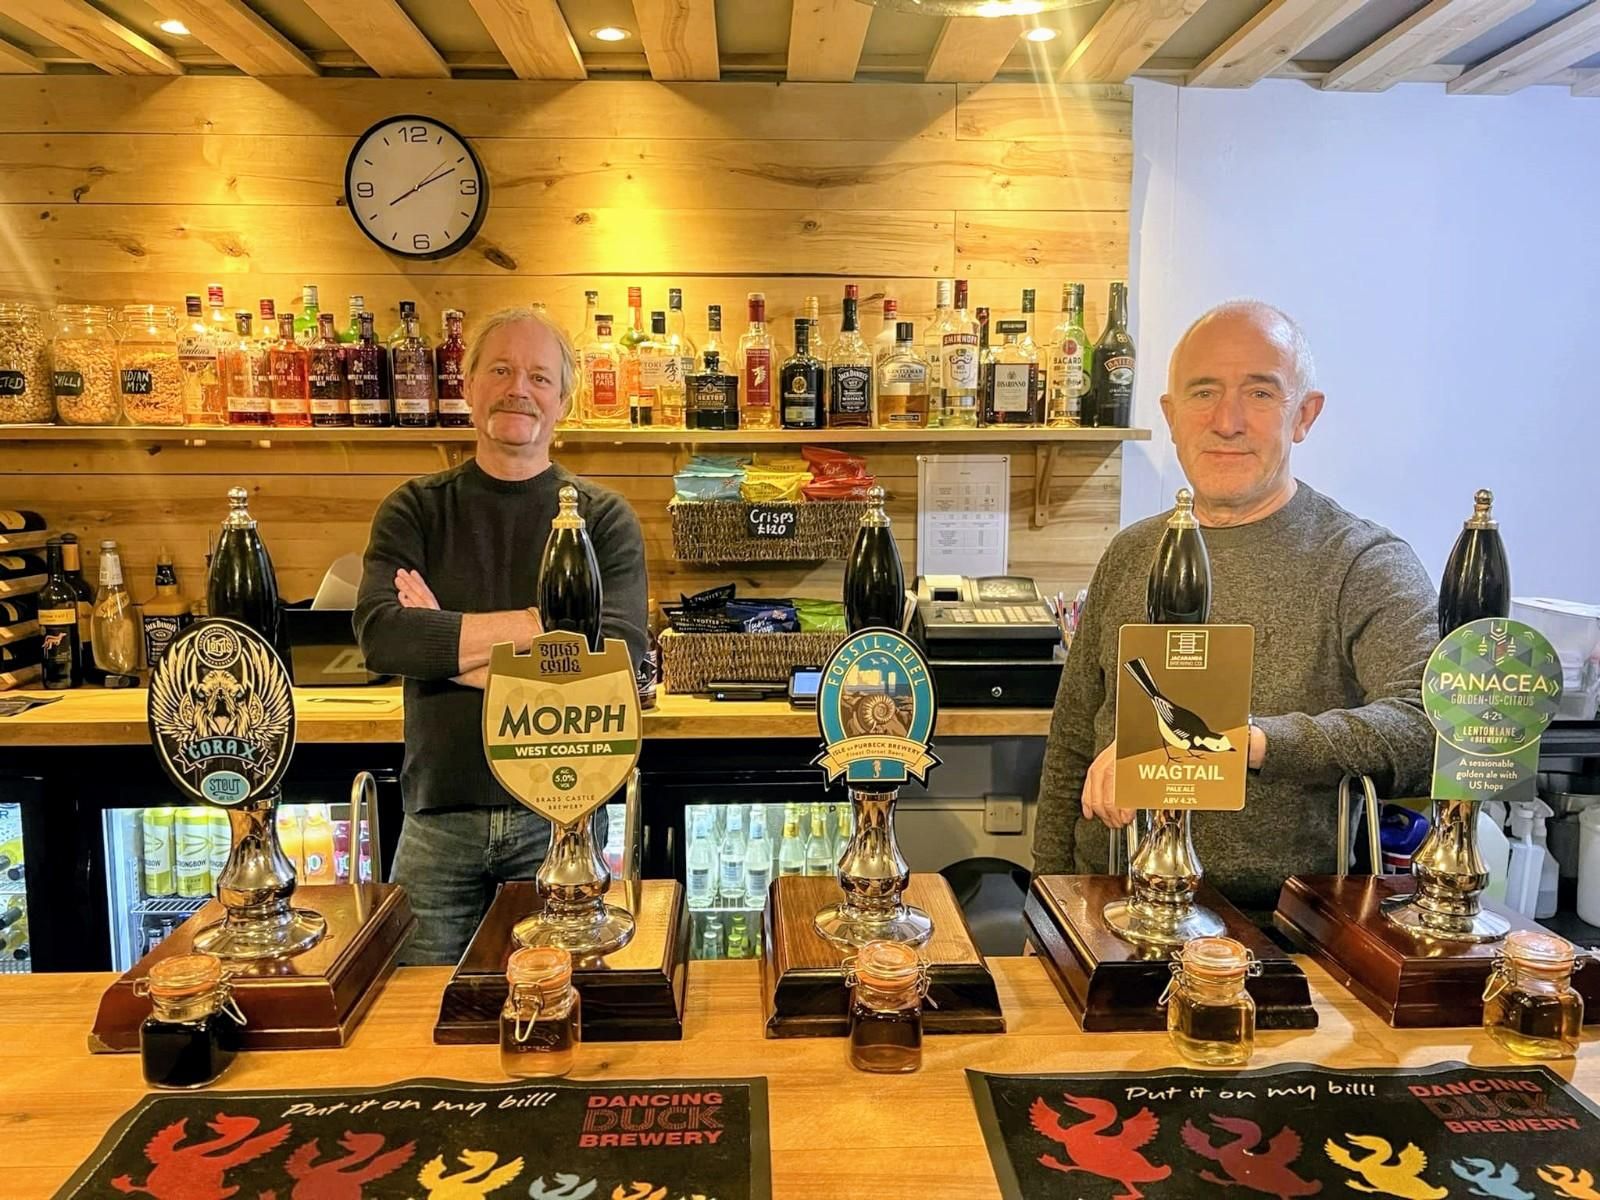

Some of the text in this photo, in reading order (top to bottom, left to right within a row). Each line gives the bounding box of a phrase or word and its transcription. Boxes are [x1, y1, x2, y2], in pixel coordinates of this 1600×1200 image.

[398, 126, 428, 143] 12
[357, 182, 374, 198] 9
[460, 179, 477, 195] 3
[413, 234, 430, 249] 6
[1053, 357, 1082, 365] BACARD
[0, 376, 24, 389] TED
[123, 371, 149, 382] NDIAN
[750, 509, 794, 525] Crisps
[827, 638, 926, 687] FOSSIL FUEL
[1439, 672, 1549, 693] PANACEA
[498, 704, 626, 738] MORPH
[188, 739, 258, 761] CORAX
[515, 743, 612, 757] WEST COAST IPA
[832, 747, 846, 757] ISLE
[887, 742, 921, 756] BREWERY
[1459, 758, 1514, 768] A sessionable
[1138, 764, 1225, 781] WAGTAIL
[1456, 769, 1518, 781] golden ale with
[209, 779, 240, 796] STOUT
[1469, 781, 1504, 792] US hops
[565, 794, 595, 802] CASTLE
[1125, 1080, 1376, 1100] Put it on my bill!
[1407, 1079, 1543, 1098] DANCING
[280, 1092, 557, 1118] Put it on my bill!
[587, 1092, 724, 1108] DANCING
[1420, 1091, 1576, 1119] DUCK
[582, 1105, 725, 1132] DUCK
[1444, 1117, 1582, 1134] BREWERY
[578, 1130, 723, 1147] BREWERY
